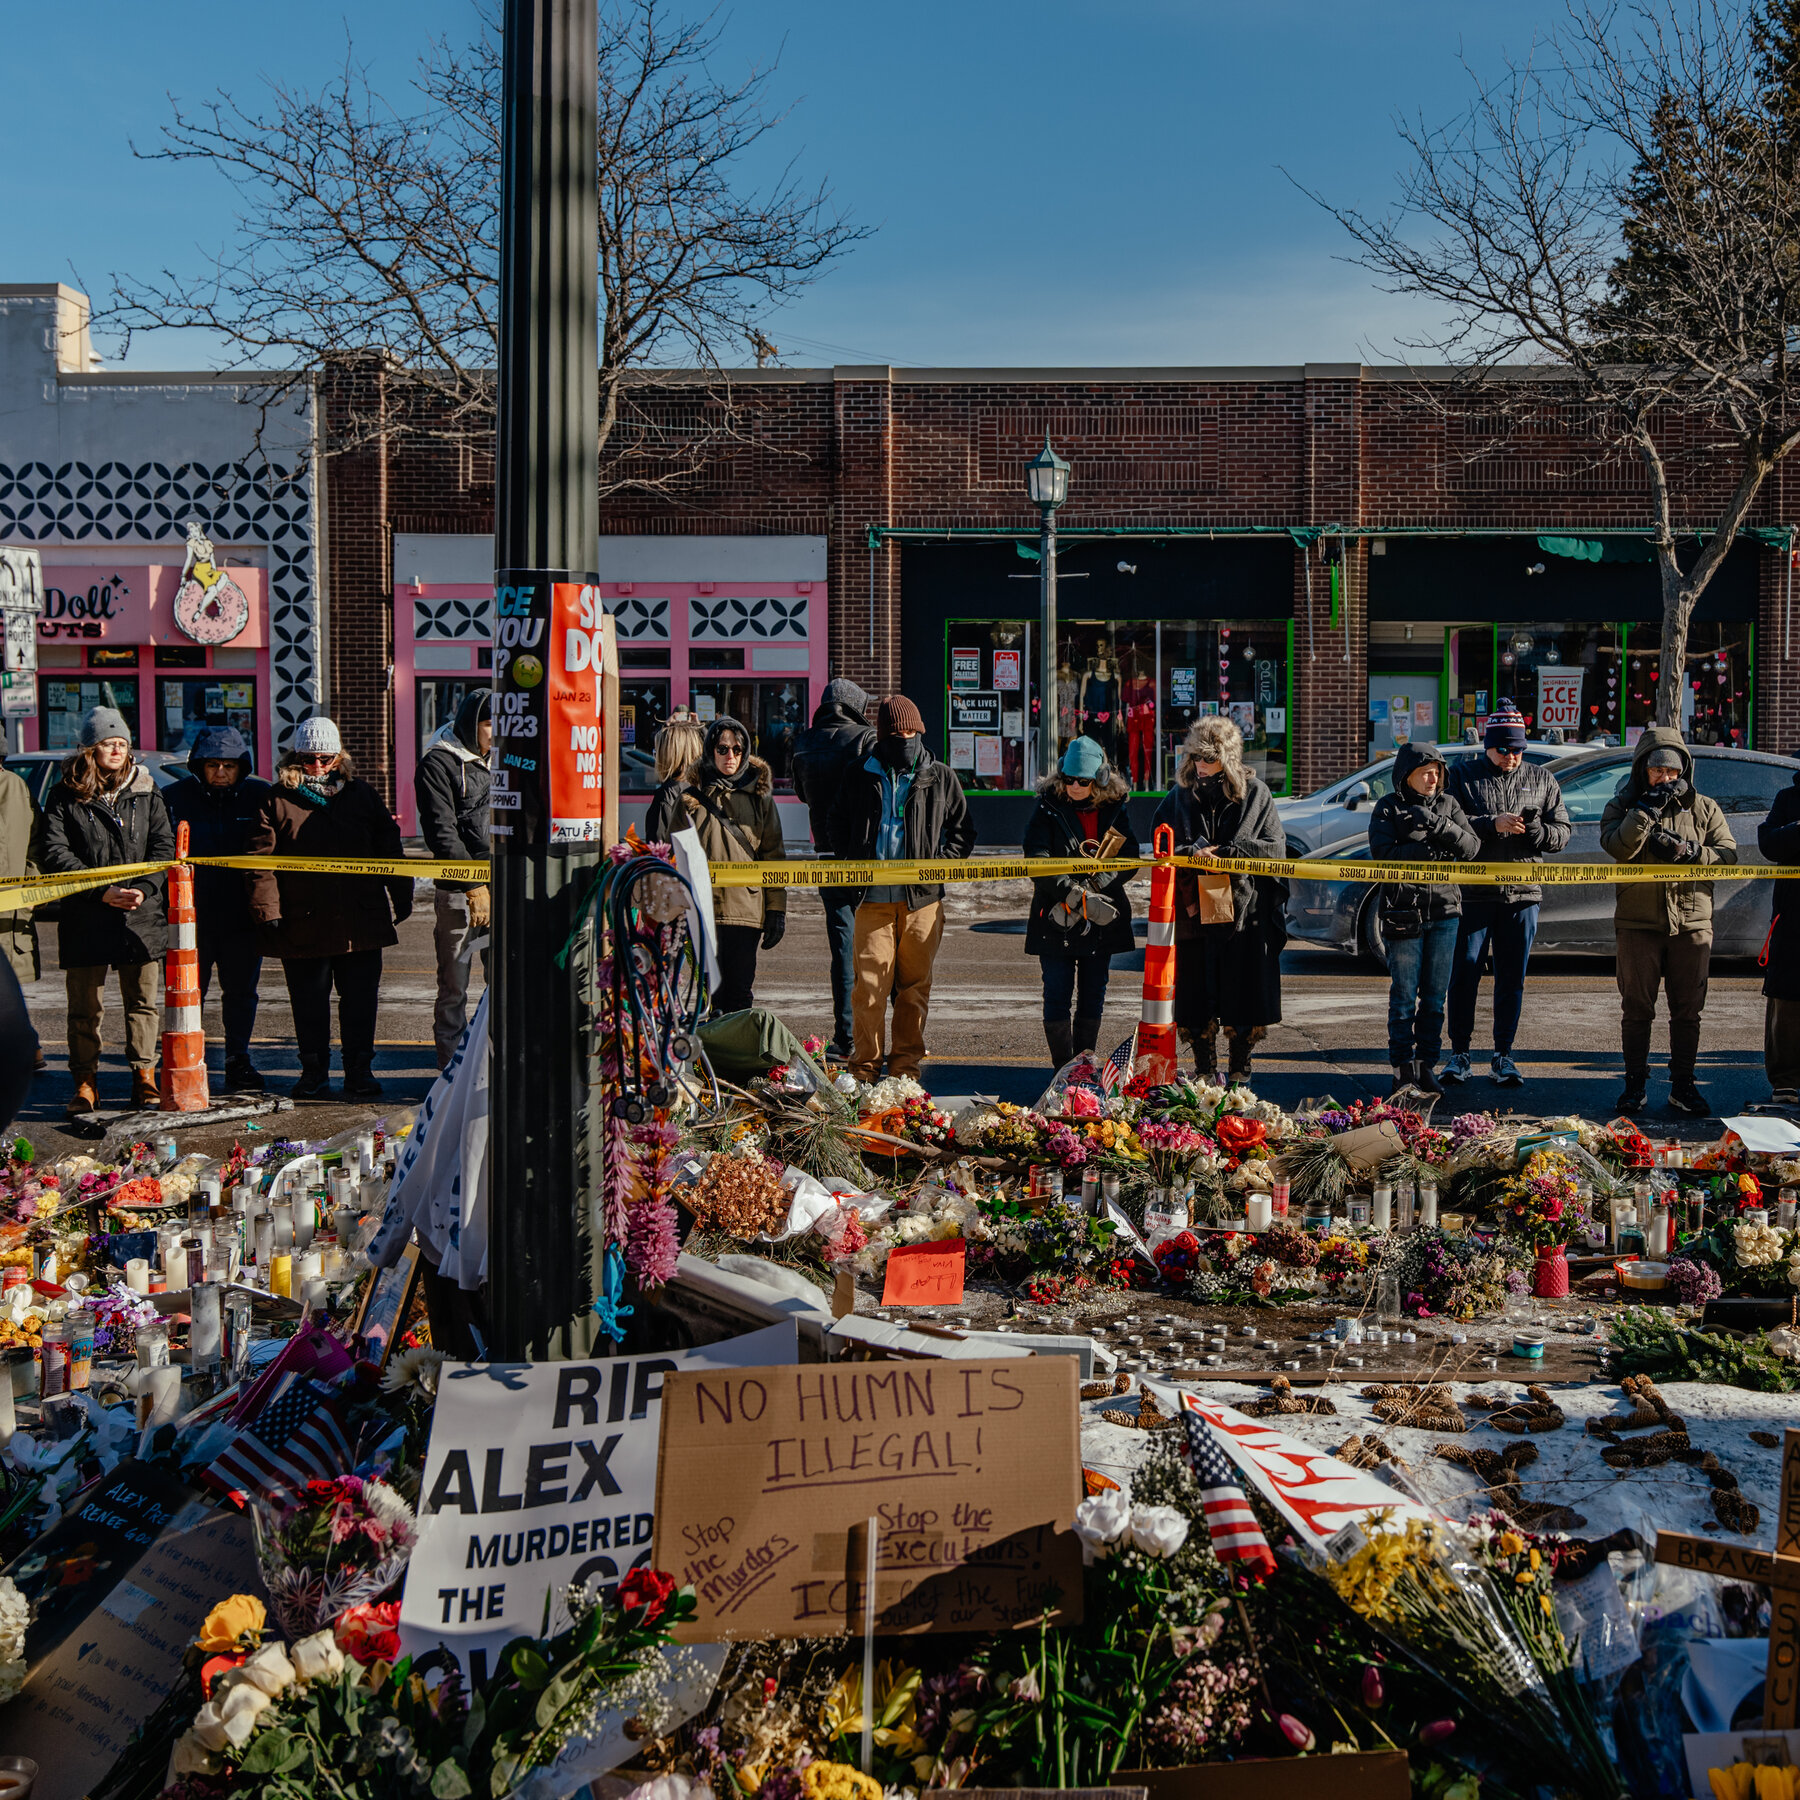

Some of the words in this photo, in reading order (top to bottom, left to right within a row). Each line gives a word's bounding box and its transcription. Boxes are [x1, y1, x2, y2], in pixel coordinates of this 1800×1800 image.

[0, 591, 17, 601] NLY
[43, 585, 116, 619] Doll
[8, 630, 33, 643] ROUTE
[955, 661, 978, 671] FREE
[553, 690, 577, 702] JAN
[578, 691, 592, 702] 23
[1543, 687, 1577, 705] ICE
[503, 692, 530, 714] OF
[977, 699, 997, 708] LIVES
[962, 712, 988, 720] MATTER
[1542, 706, 1580, 724] OUT!
[503, 753, 522, 768] JAN
[521, 758, 537, 771] 23
[557, 827, 580, 837] ATU
[1186, 855, 1214, 868] CROSS
[1214, 858, 1233, 869] NOT
[1234, 858, 1246, 871] DO
[1247, 860, 1267, 872] LINE
[440, 868, 469, 879] CROSS
[471, 869, 491, 880] NOT
[918, 869, 946, 881] CROSS
[947, 868, 964, 880] NOT
[967, 867, 978, 879] DO
[979, 867, 999, 879] LINE
[1000, 865, 1028, 878] POLICE
[1267, 862, 1296, 875] POLICE
[1339, 866, 1367, 879] CROSS
[1367, 867, 1386, 880] NOT
[1388, 868, 1400, 880] DO
[1401, 869, 1420, 881] LINE
[762, 872, 790, 884] CROSS
[792, 872, 809, 884] NOT
[811, 871, 823, 884] DO
[825, 871, 845, 883] LINE
[846, 870, 874, 883] POLICE
[1422, 869, 1450, 882] POLICE
[552, 1358, 678, 1429] RIP
[697, 1380, 768, 1423] NO
[797, 1369, 935, 1422] HUMN
[957, 1369, 1025, 1418] IS
[767, 1427, 982, 1482] ILLEGAL!
[422, 1433, 624, 1515] ALEX
[104, 1481, 148, 1509] ALEX
[79, 1502, 129, 1531] RENEE
[878, 1502, 939, 1532] Stop
[951, 1502, 993, 1528] the
[466, 1512, 654, 1569] MURDERED
[682, 1515, 736, 1557] Stop
[875, 1528, 1043, 1570] Executions!
[683, 1547, 727, 1583] the
[1677, 1540, 1771, 1578] BRAVE
[438, 1583, 506, 1624] THE
[790, 1579, 871, 1621] ICE
[953, 1578, 996, 1606] the
